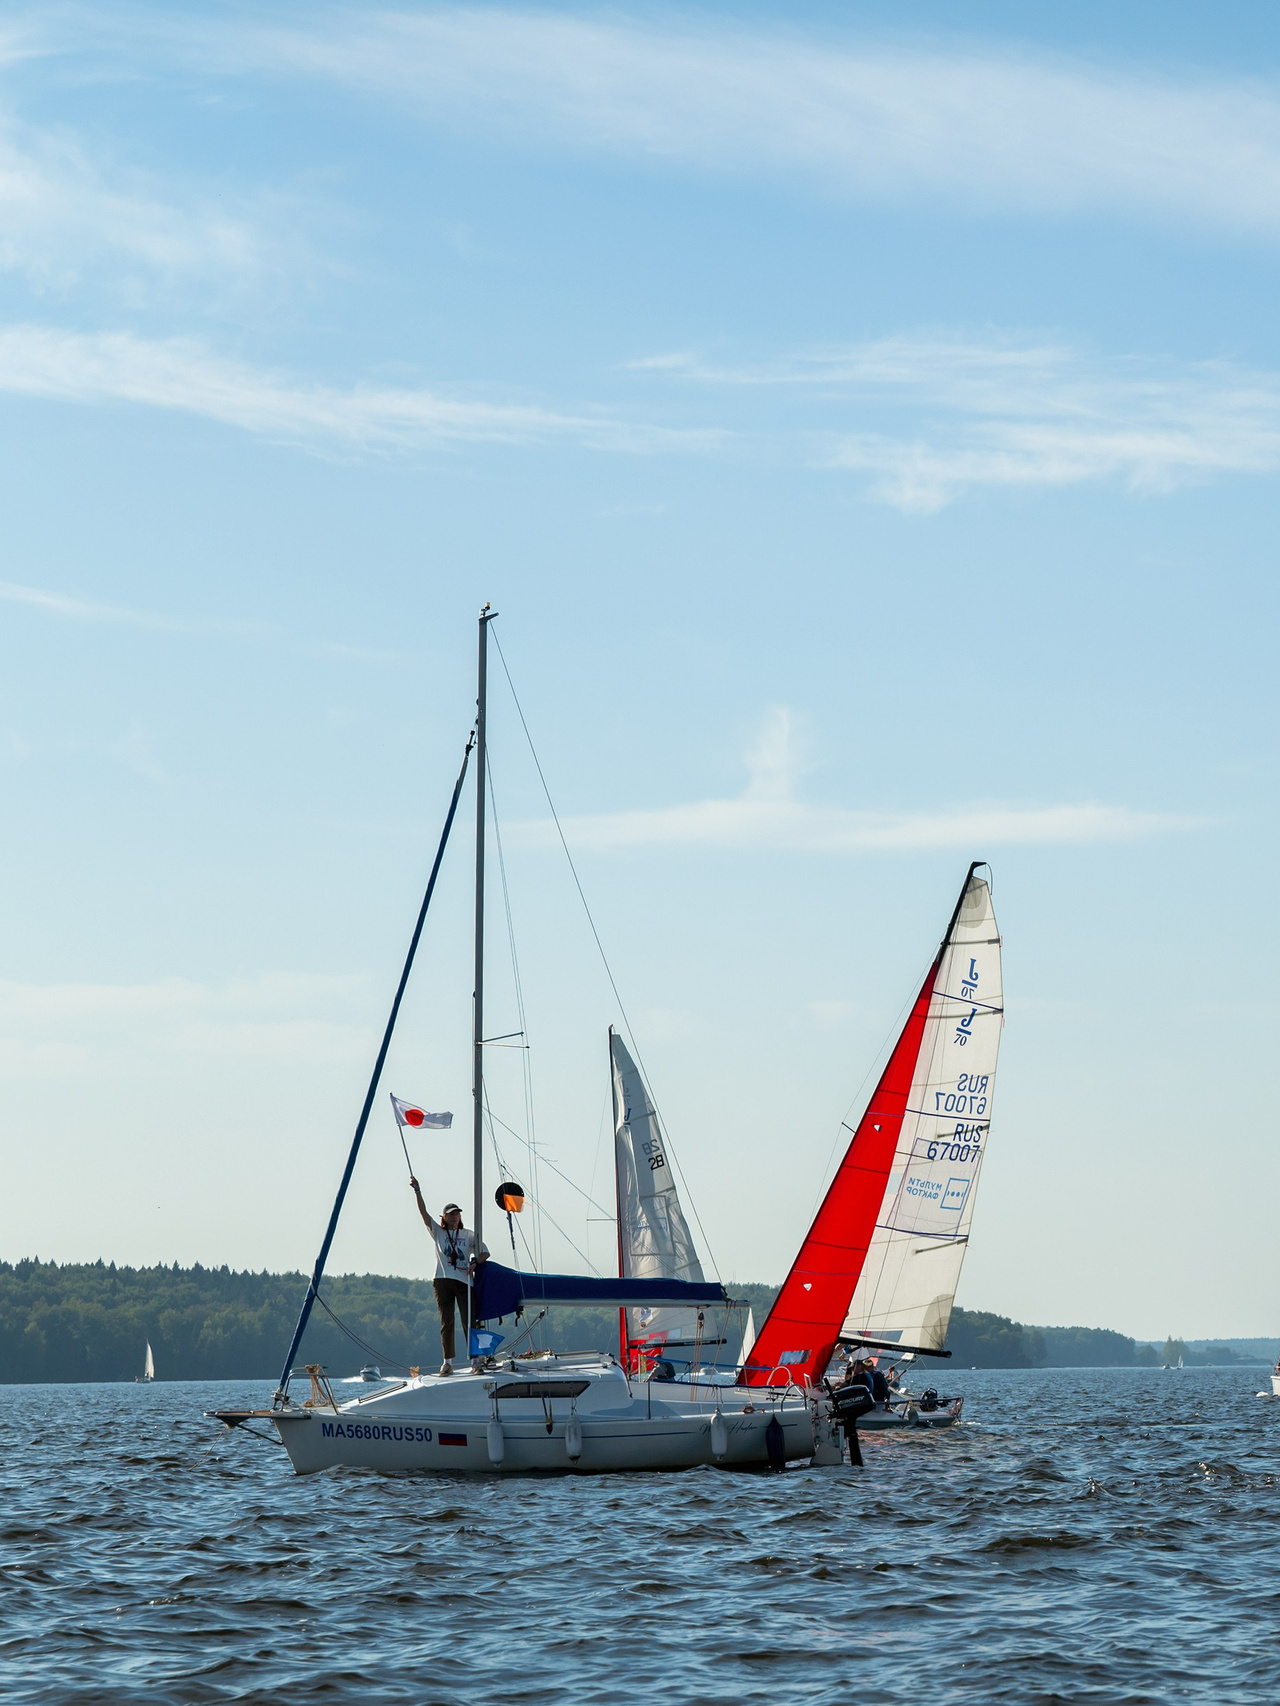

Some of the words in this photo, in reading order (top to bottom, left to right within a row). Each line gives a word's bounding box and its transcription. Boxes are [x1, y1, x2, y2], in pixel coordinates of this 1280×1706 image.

[960, 1008, 977, 1028] J
[953, 1033, 968, 1047] 70
[953, 1123, 984, 1143] RUS
[927, 1141, 981, 1163] 67007
[648, 1154, 665, 1170] 28
[321, 1423, 433, 1442] MA5680RUS50
